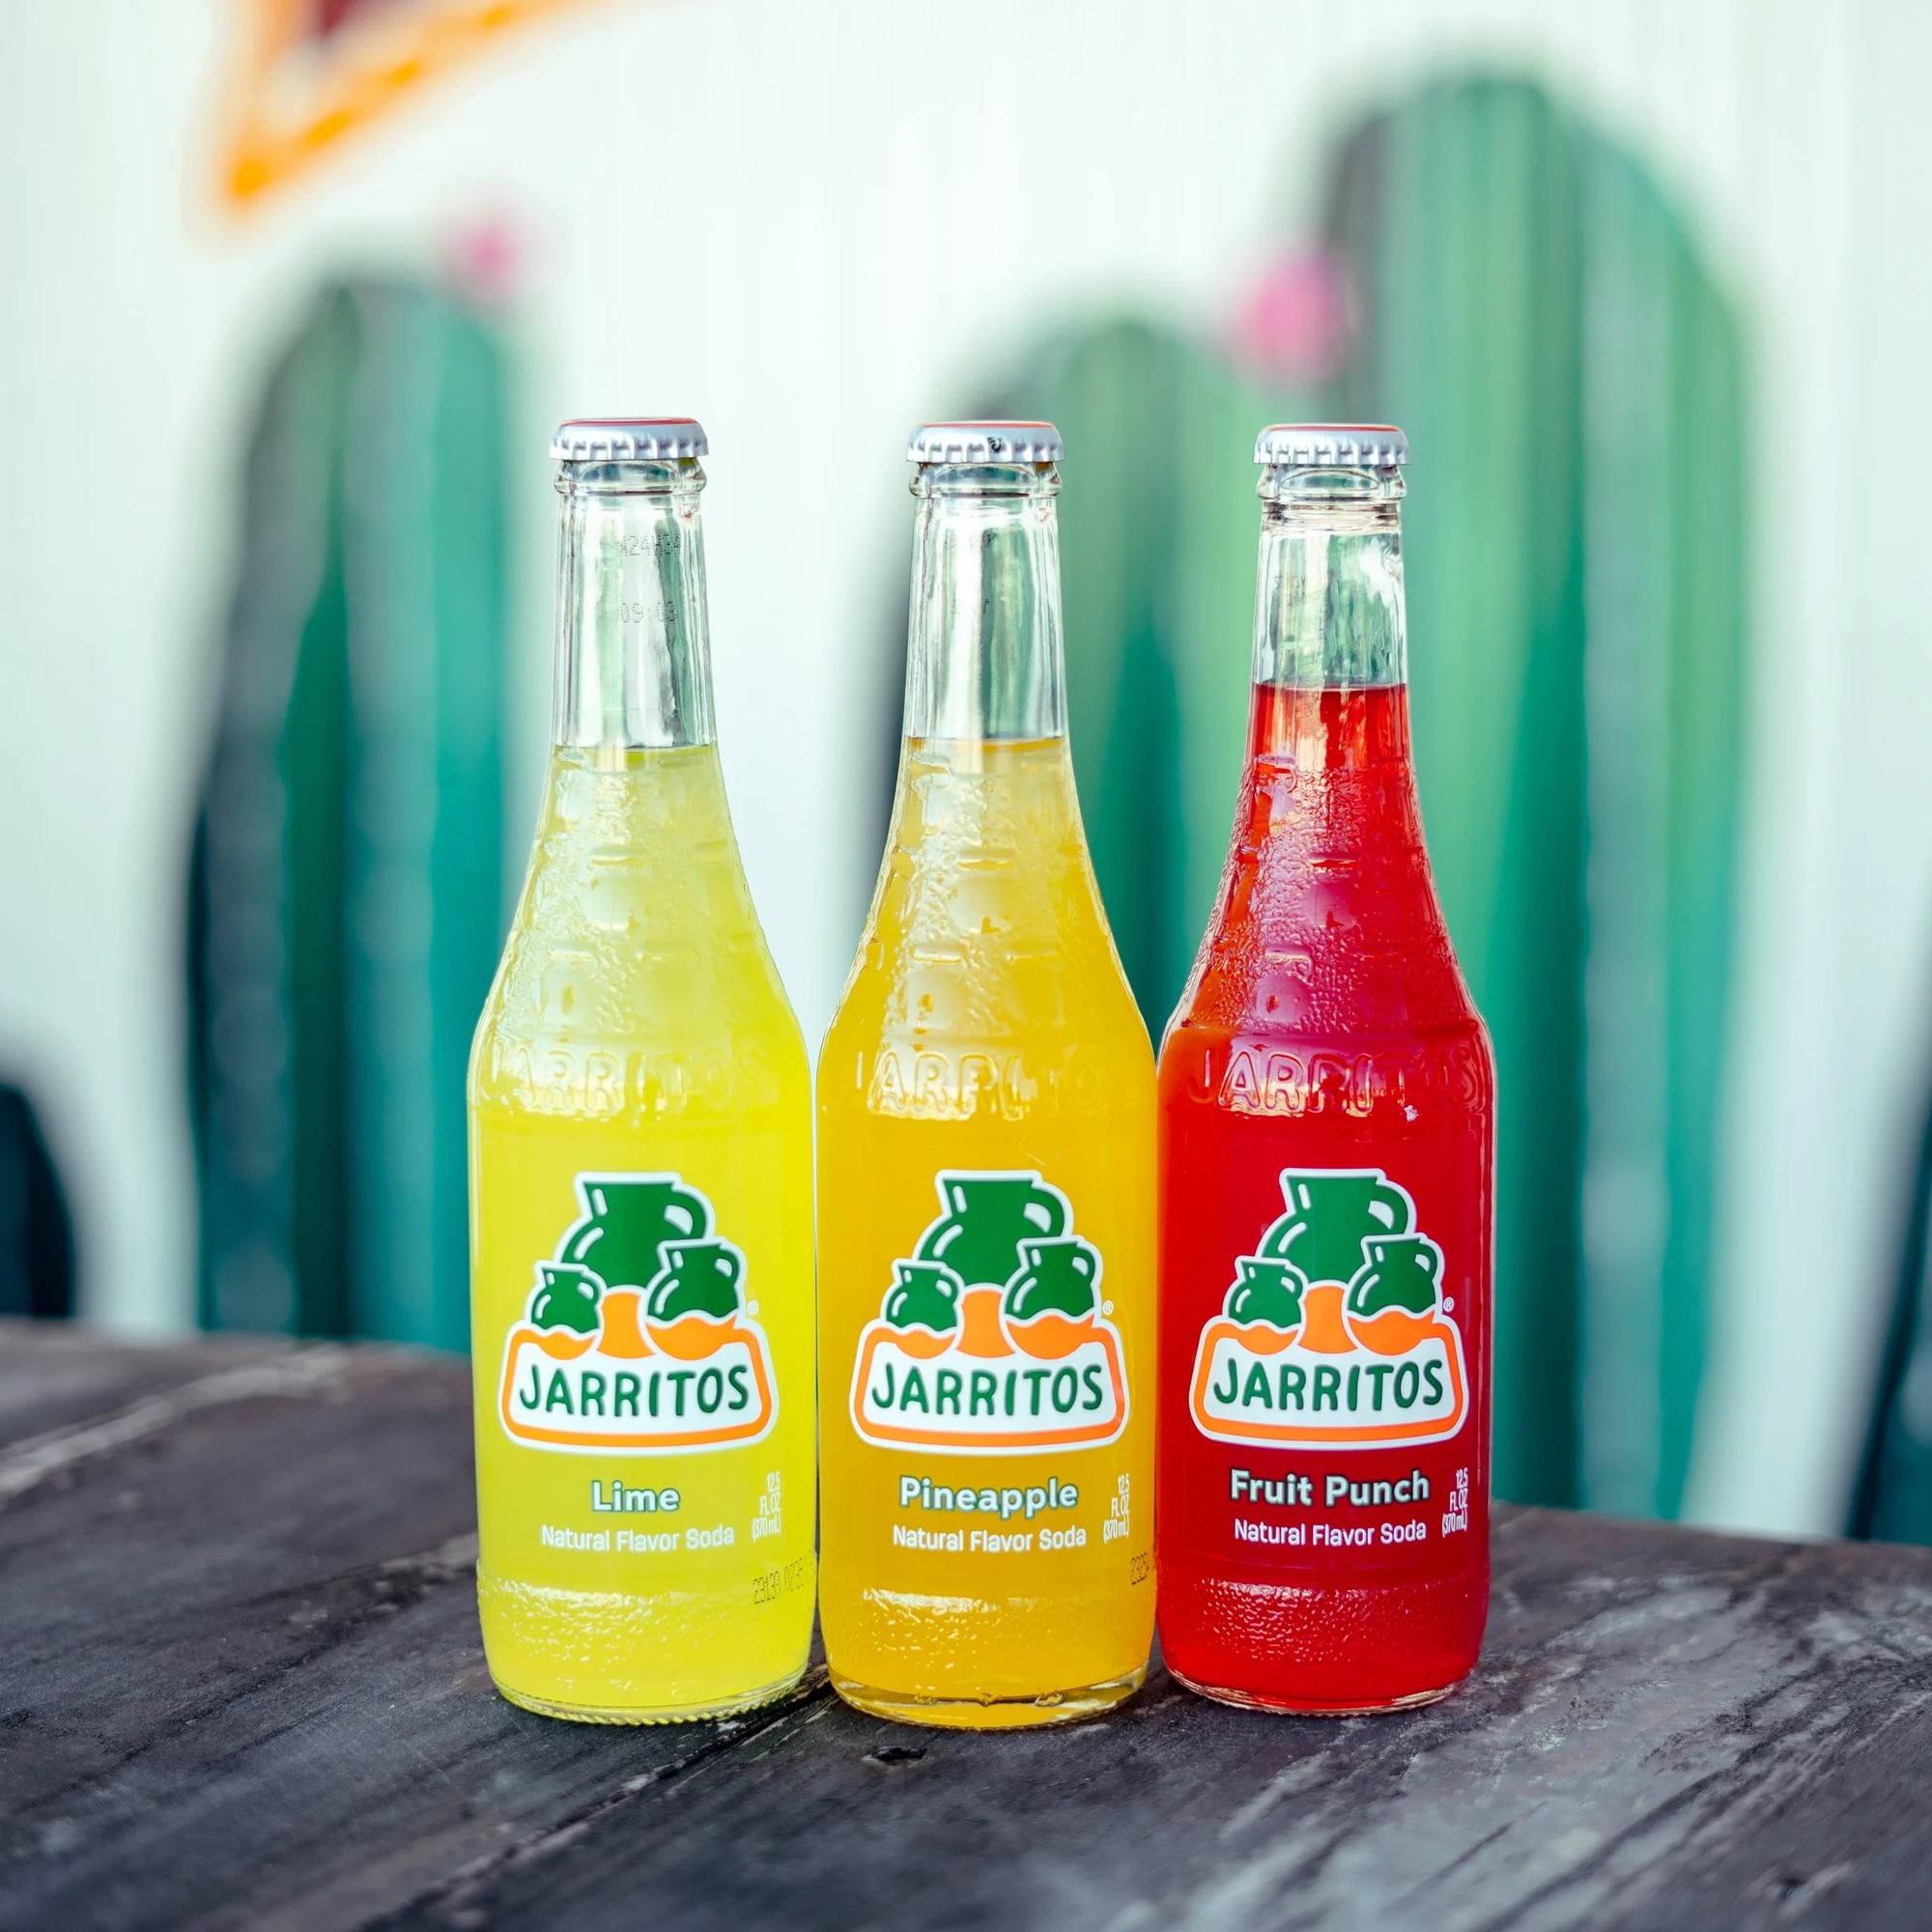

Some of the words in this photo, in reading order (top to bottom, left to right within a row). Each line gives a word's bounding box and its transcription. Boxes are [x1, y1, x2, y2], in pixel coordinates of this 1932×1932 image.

[520, 1364, 748, 1417] JARRITOS
[871, 1362, 1102, 1416] JARRITOS
[1213, 1358, 1442, 1411] JARRITOS
[591, 1480, 680, 1512] Lime
[899, 1475, 1078, 1519] Pineapple
[1230, 1468, 1312, 1506] Fruit
[1325, 1468, 1431, 1507] Punch
[541, 1524, 610, 1551] Natural
[617, 1530, 679, 1552] Flavor
[686, 1524, 734, 1549] Soda
[894, 1524, 963, 1551] Natural
[970, 1531, 1033, 1552] Flavor
[1039, 1525, 1087, 1550] Soda
[1235, 1518, 1305, 1546] Natural
[1313, 1524, 1375, 1546] Flavor
[1380, 1520, 1427, 1544] Soda
